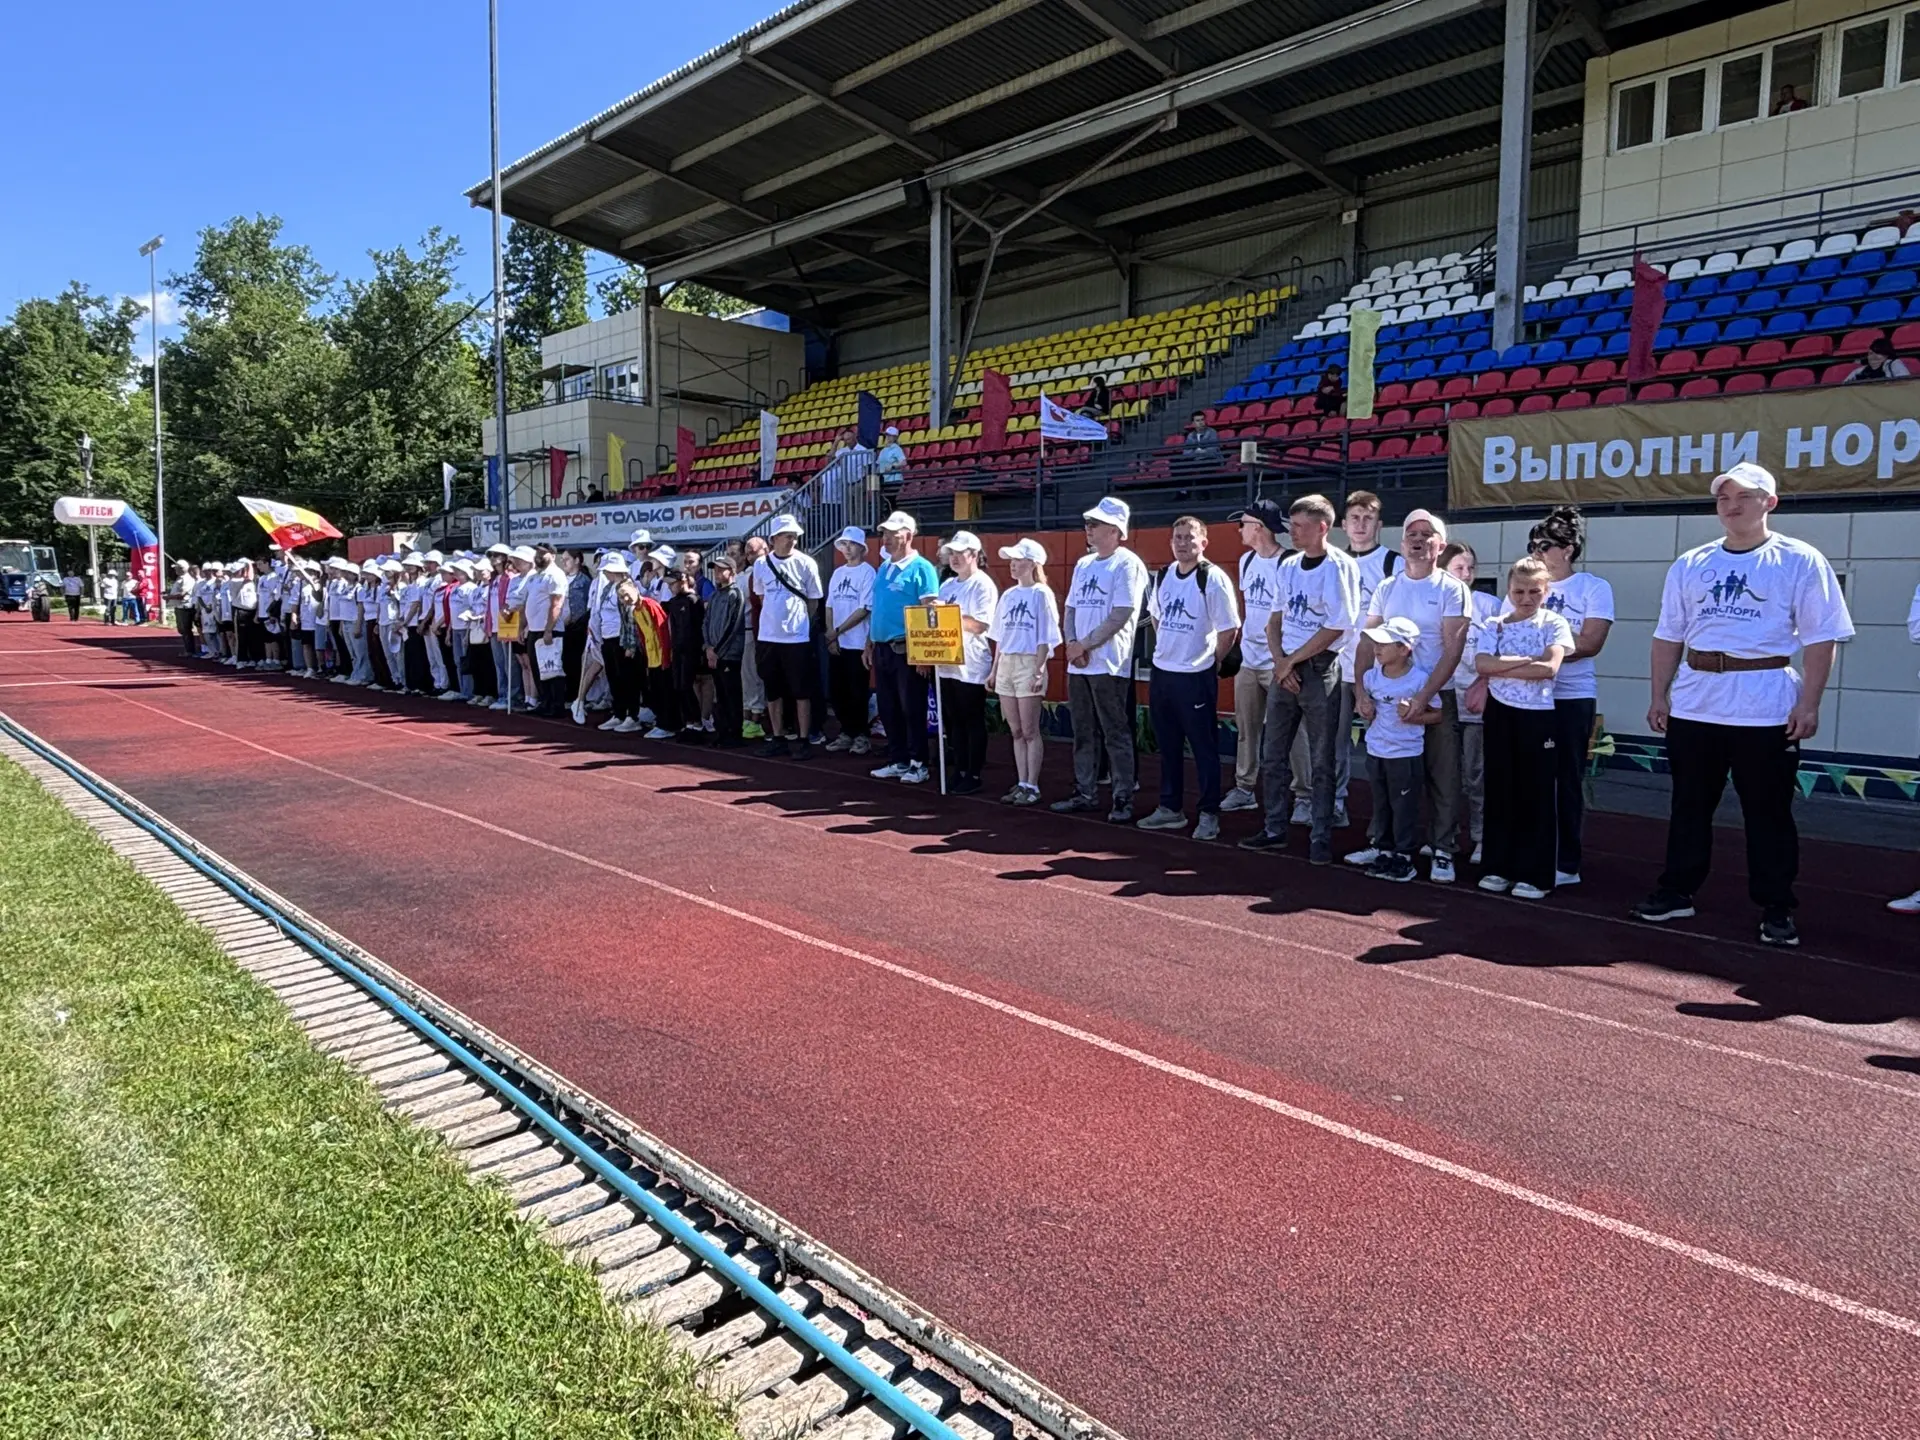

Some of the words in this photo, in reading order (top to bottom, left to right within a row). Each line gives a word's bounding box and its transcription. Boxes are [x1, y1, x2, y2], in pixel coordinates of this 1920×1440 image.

[1482, 430, 1759, 485] Выполни
[1785, 417, 1920, 479] нор
[484, 518, 538, 532] ТОЬКО
[541, 512, 598, 529] РОТОР!
[601, 507, 675, 525] ТОЛЬКО
